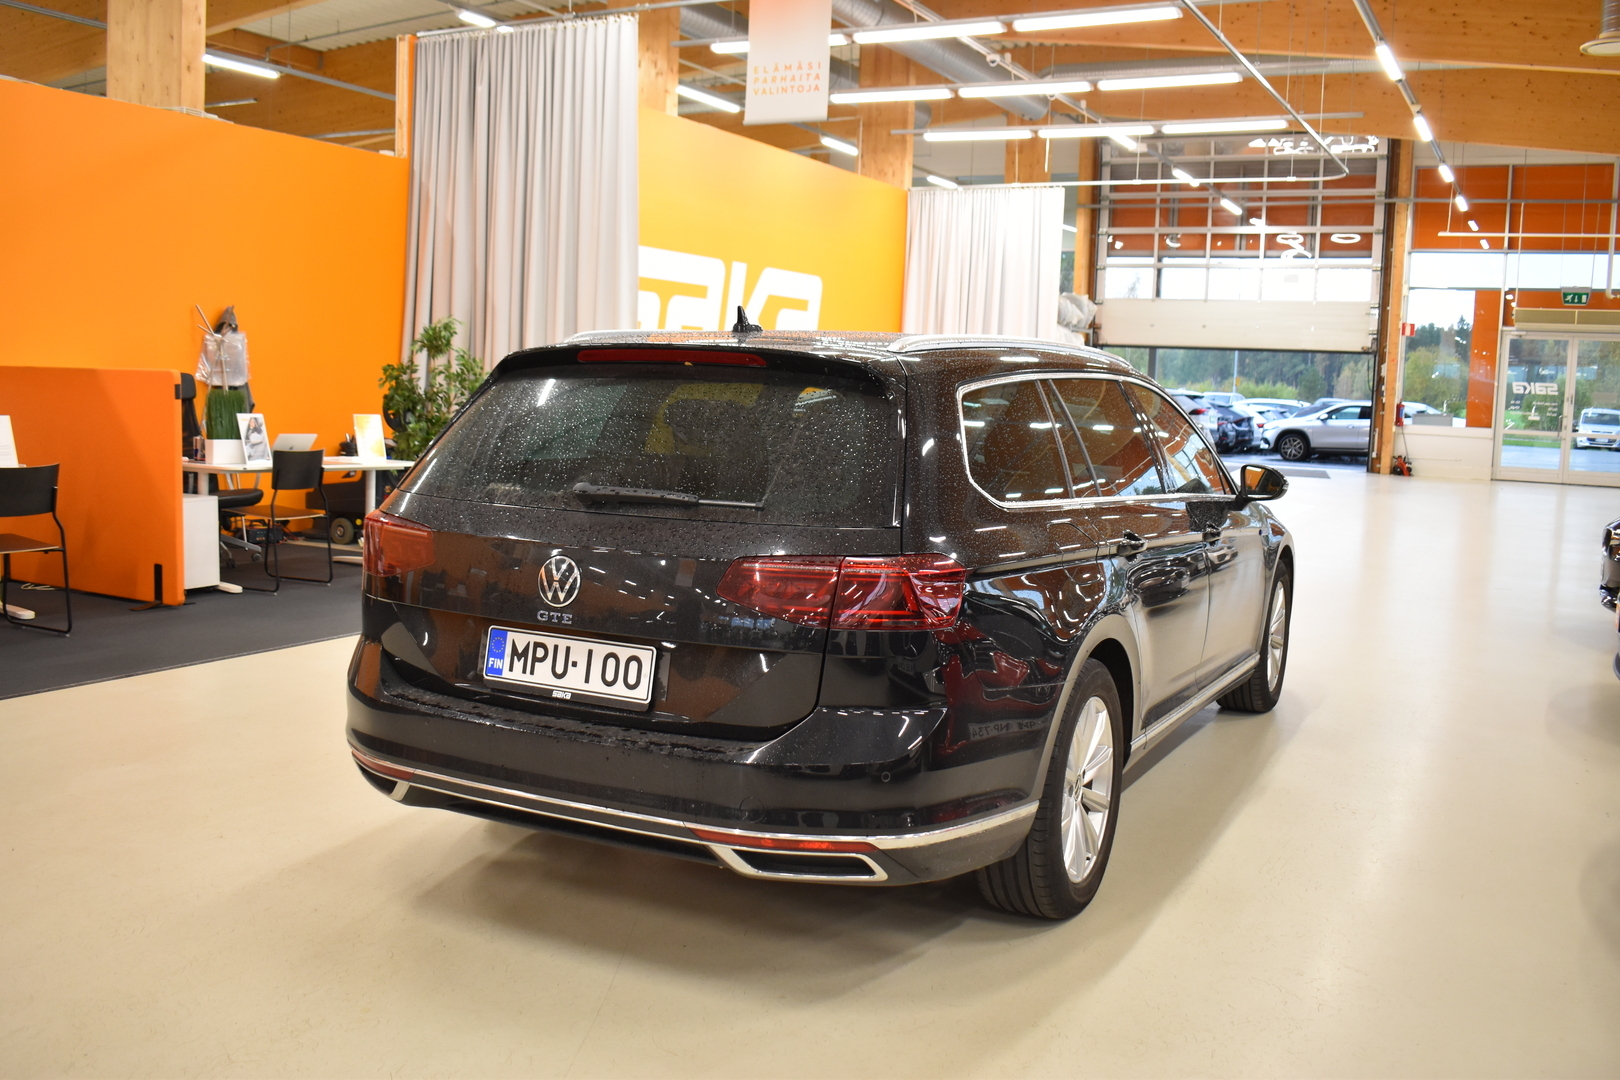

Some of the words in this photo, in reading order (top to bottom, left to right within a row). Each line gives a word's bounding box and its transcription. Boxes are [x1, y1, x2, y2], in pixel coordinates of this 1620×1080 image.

[753, 61, 821, 74] ELÄMÄSI
[753, 73, 820, 85] PARHAITA
[753, 84, 820, 95] VALINTOJA
[537, 610, 573, 625] GTE
[488, 657, 504, 670] FIN
[508, 638, 643, 691] MPU-100
